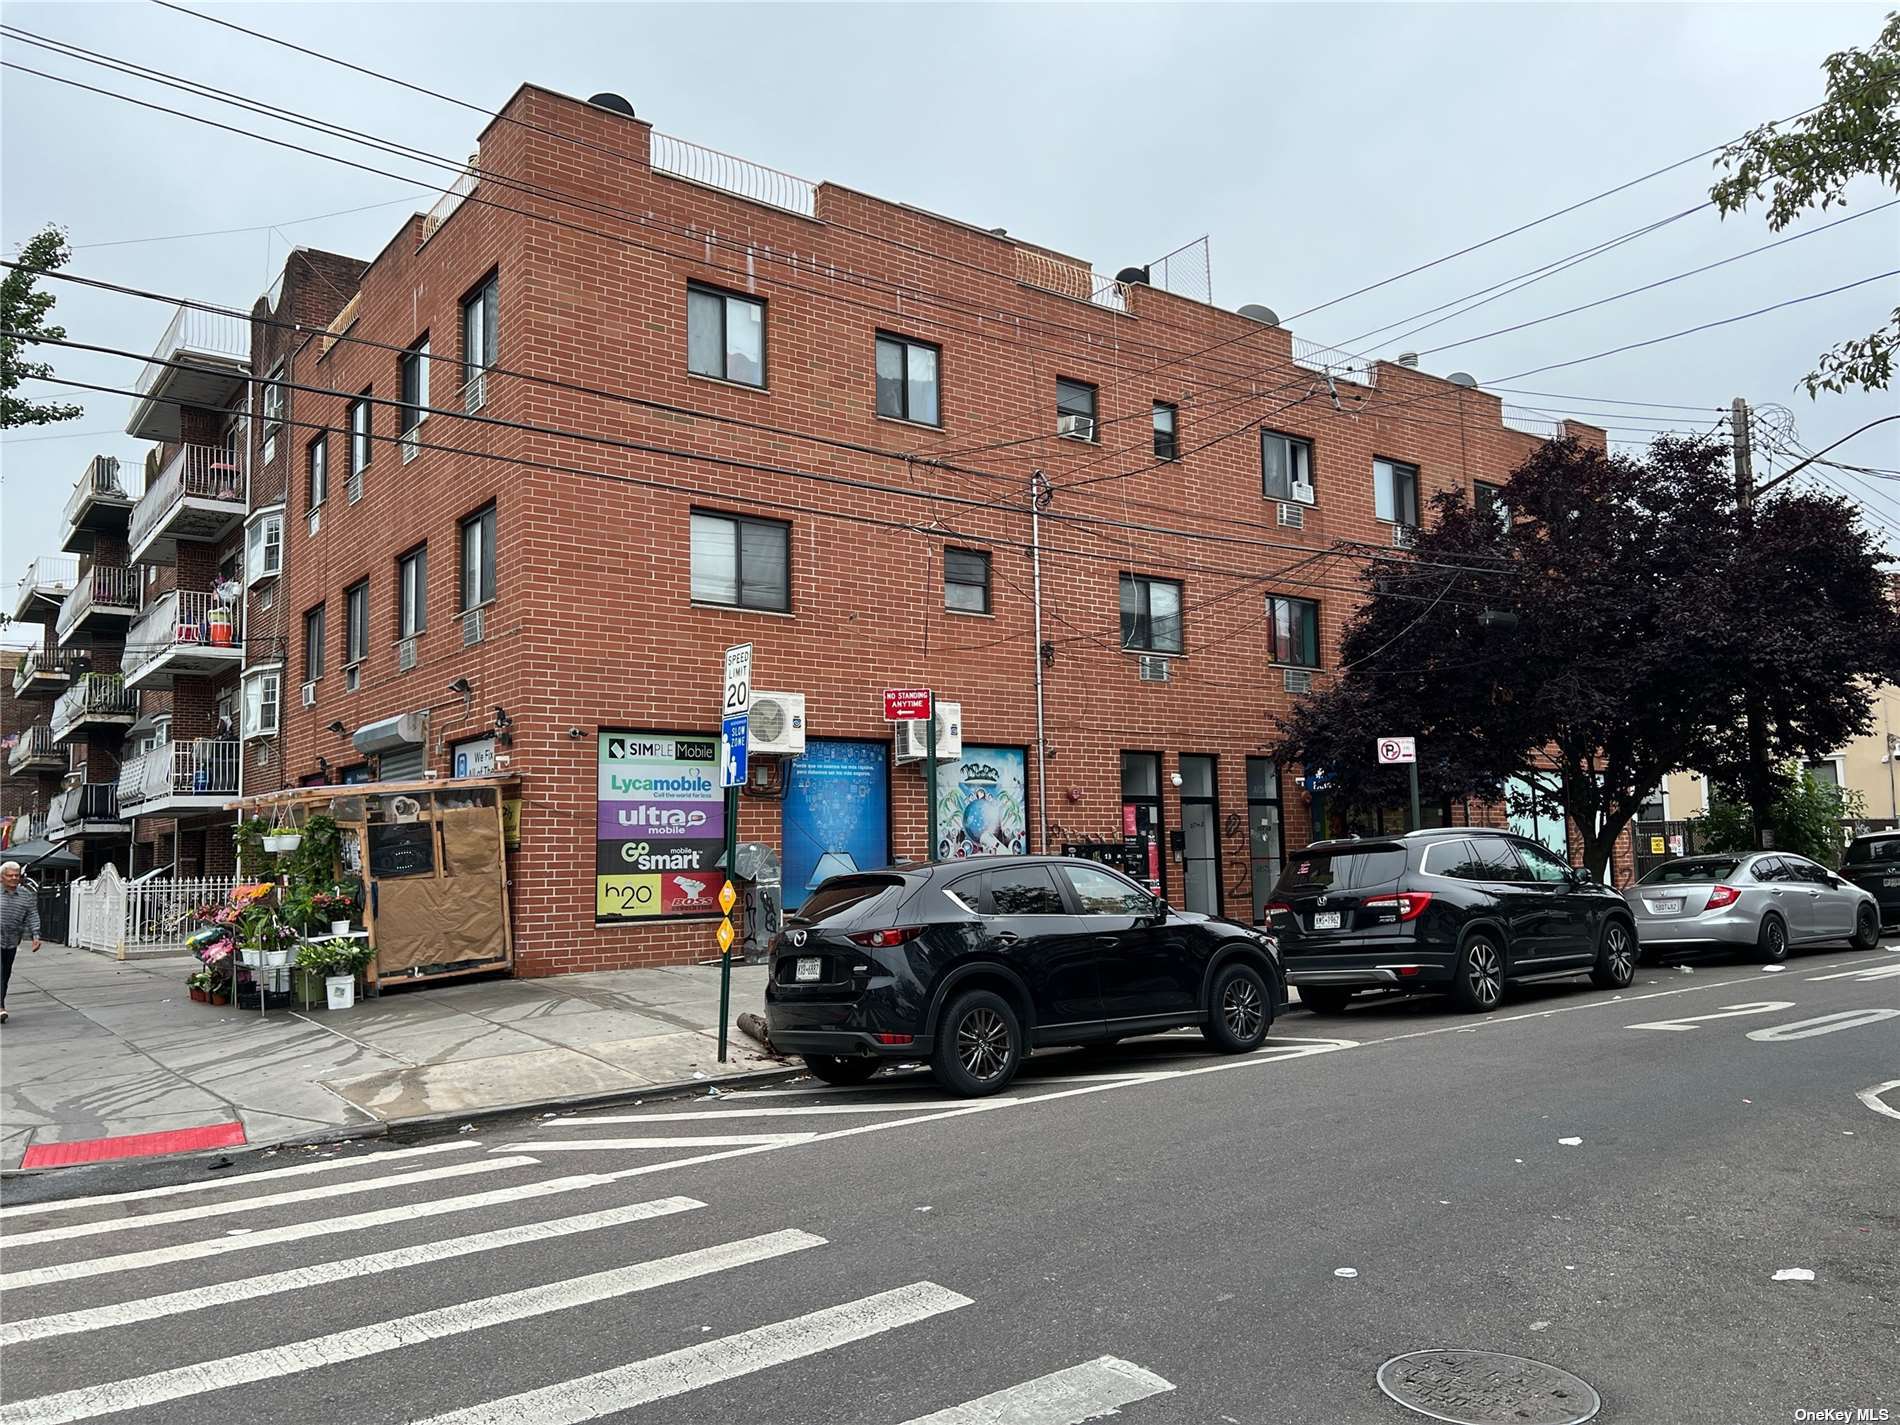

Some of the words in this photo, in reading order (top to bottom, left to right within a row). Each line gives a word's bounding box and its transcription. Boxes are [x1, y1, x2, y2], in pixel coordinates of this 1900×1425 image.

[728, 651, 749, 666] SPEED
[728, 665, 747, 679] LIMIT
[727, 681, 747, 708] 20
[886, 692, 896, 700] NO
[898, 691, 928, 700] STANDING
[892, 700, 923, 708] ANYTIME
[731, 725, 745, 737] SLOW
[731, 736, 745, 748] ZONE
[474, 751, 484, 763] We
[484, 749, 494, 761] Fix
[629, 742, 673, 757] SIMPLE
[677, 743, 713, 759] Mobile
[611, 774, 712, 793] Lycamobile
[618, 804, 686, 826] ultra
[648, 826, 686, 834] mobile
[638, 851, 700, 870] smart
[672, 897, 713, 906] BOSS
